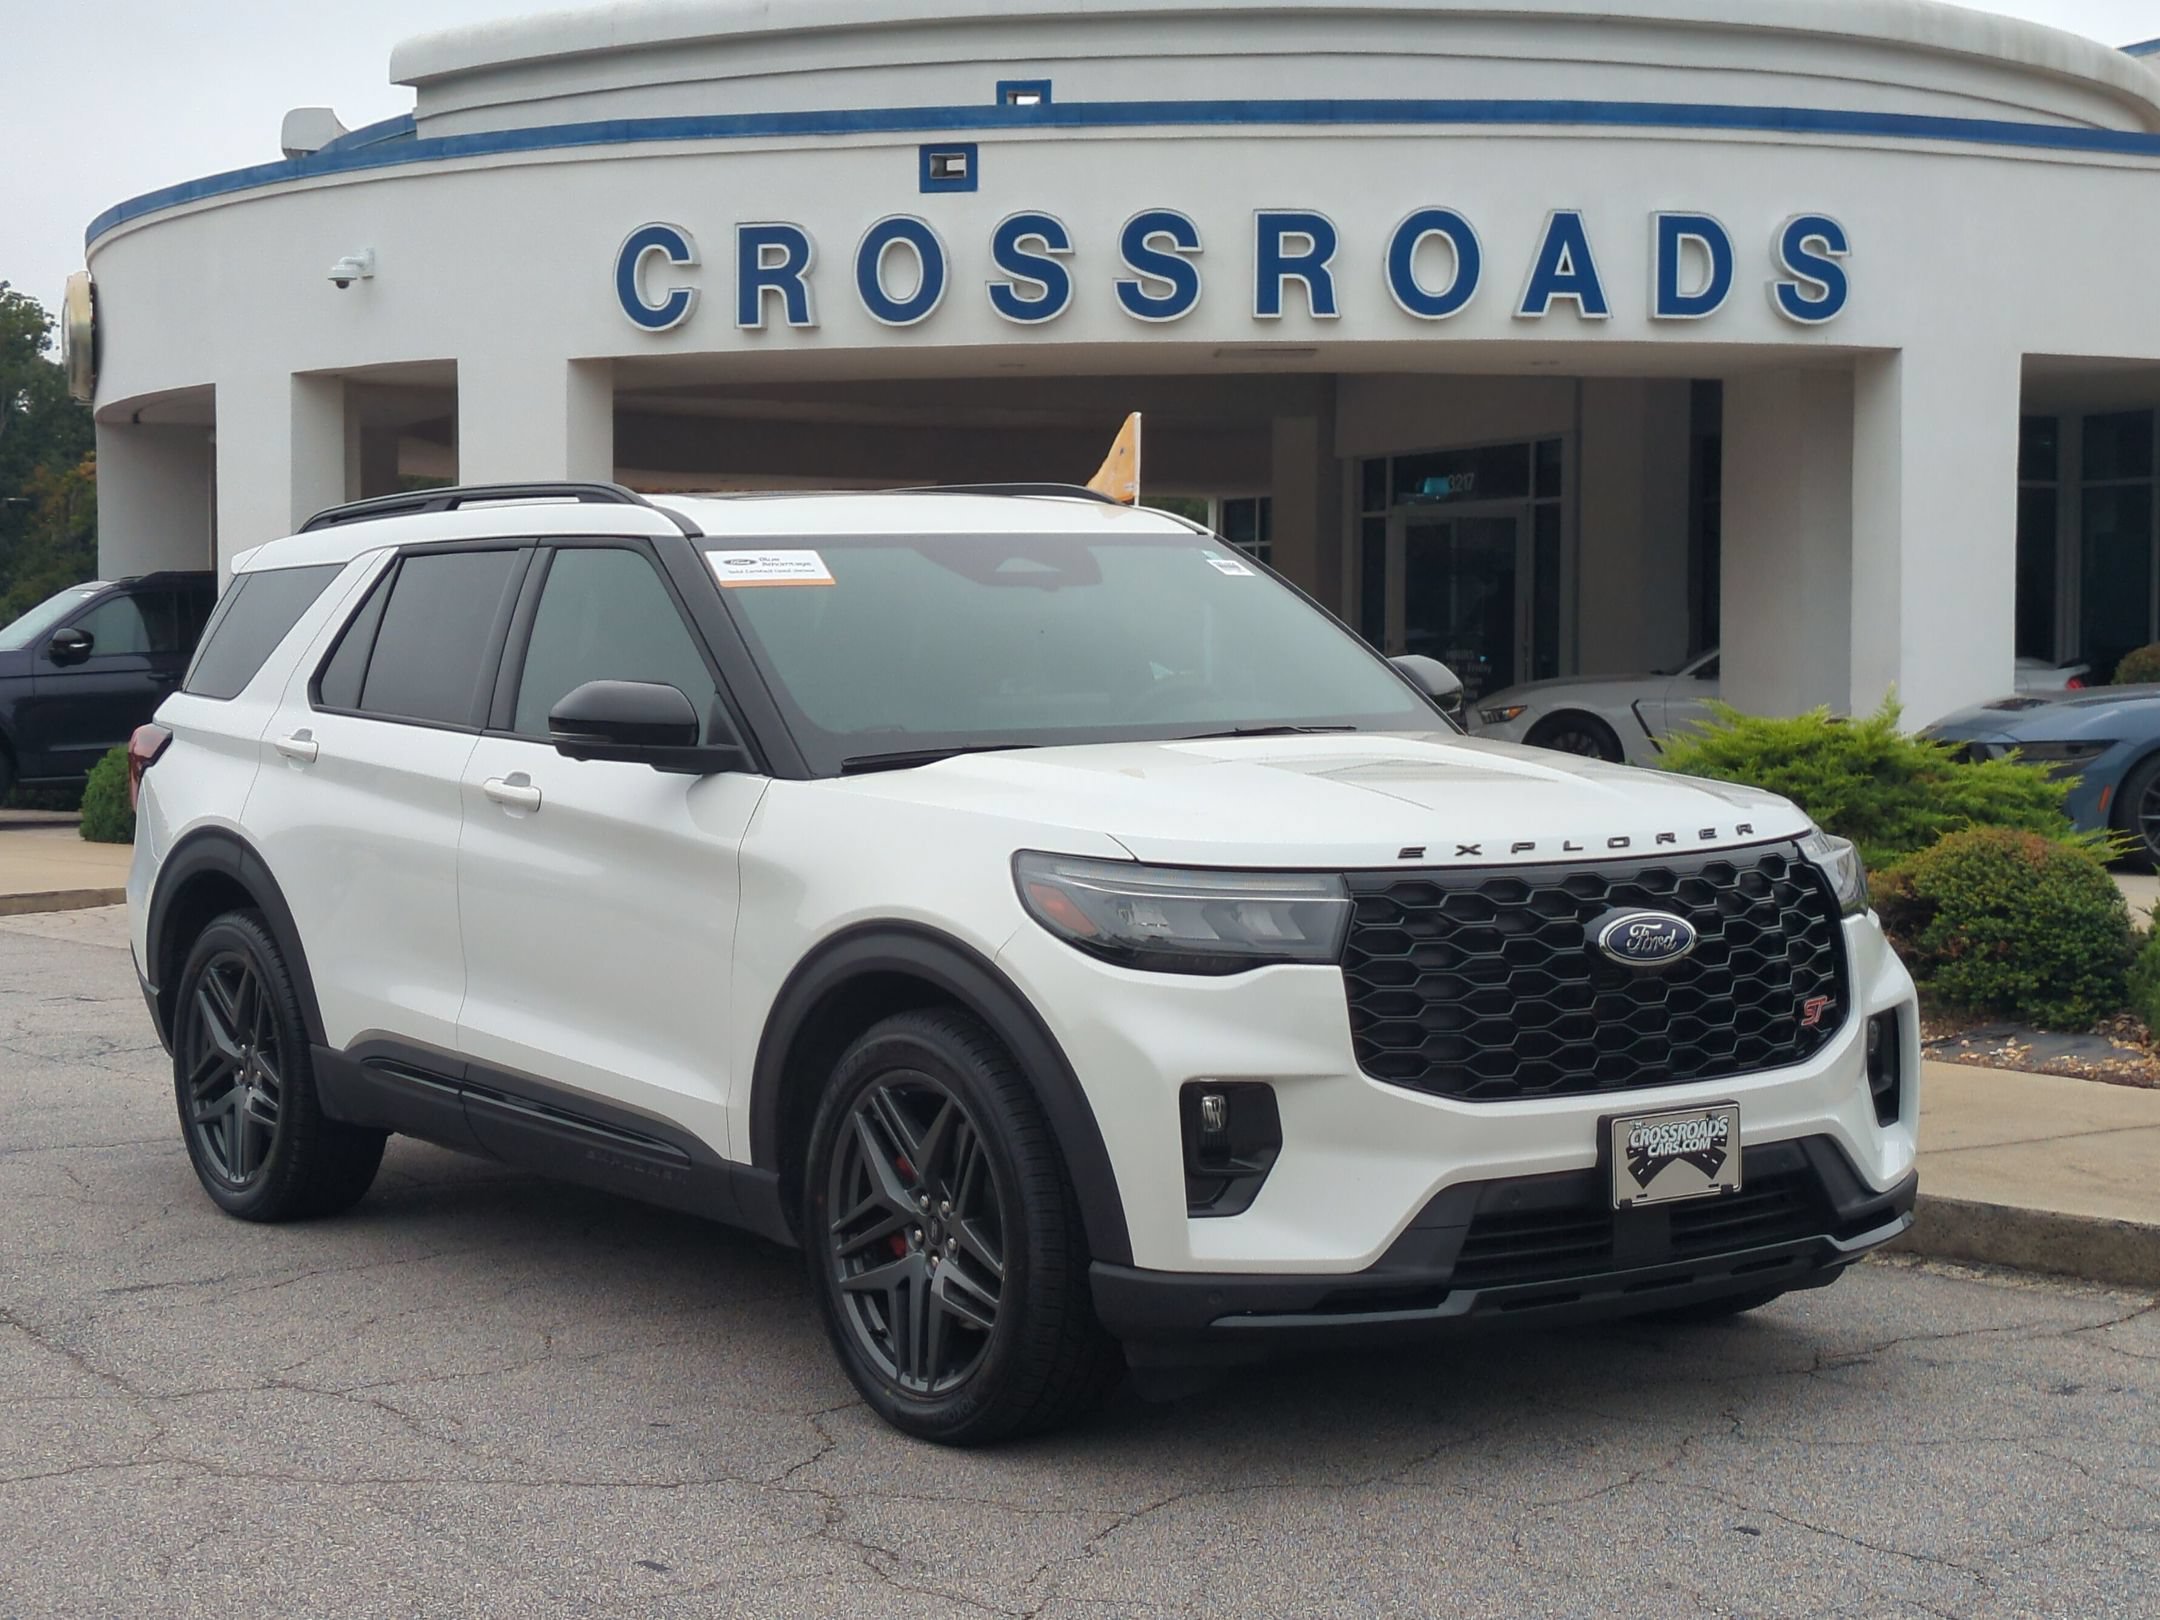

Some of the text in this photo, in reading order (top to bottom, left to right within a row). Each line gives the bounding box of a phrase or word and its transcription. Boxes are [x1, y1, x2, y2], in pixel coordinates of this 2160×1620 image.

[614, 206, 1852, 332] CROSSROADS
[1397, 823, 1754, 859] EXPLORER
[1626, 923, 1677, 954] Ford
[1801, 996, 1828, 1026] ST
[1628, 1115, 1730, 1148] CROSSROADS
[1647, 1136, 1711, 1157] CARS.COM
